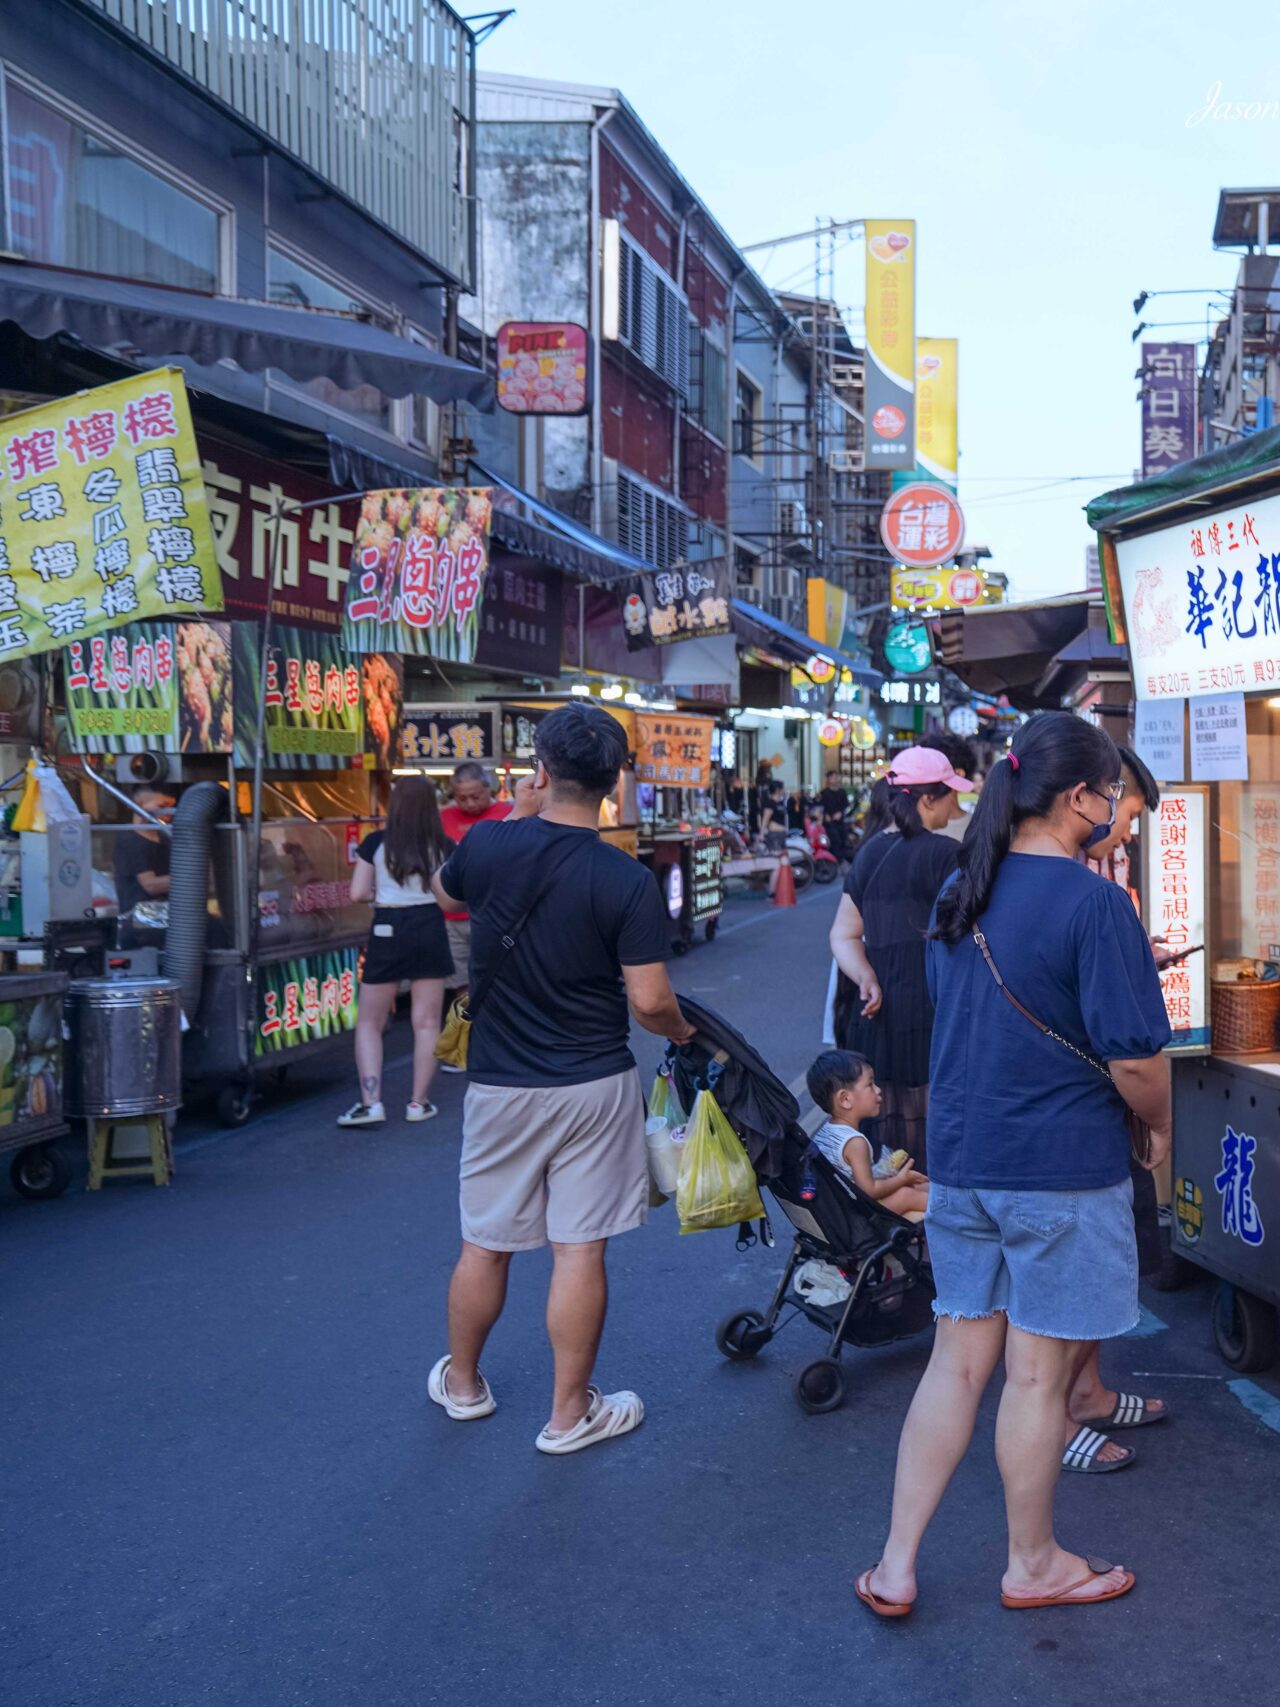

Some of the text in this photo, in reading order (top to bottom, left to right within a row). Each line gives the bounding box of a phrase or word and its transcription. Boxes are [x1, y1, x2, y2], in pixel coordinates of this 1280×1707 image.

[83, 467, 139, 618] 冬瓜檸檬
[136, 447, 205, 603] 翡翠檸檬
[1190, 513, 1260, 558] 祖傳三代
[1147, 672, 1191, 696] 每支20元
[1198, 663, 1246, 690] 三支50元
